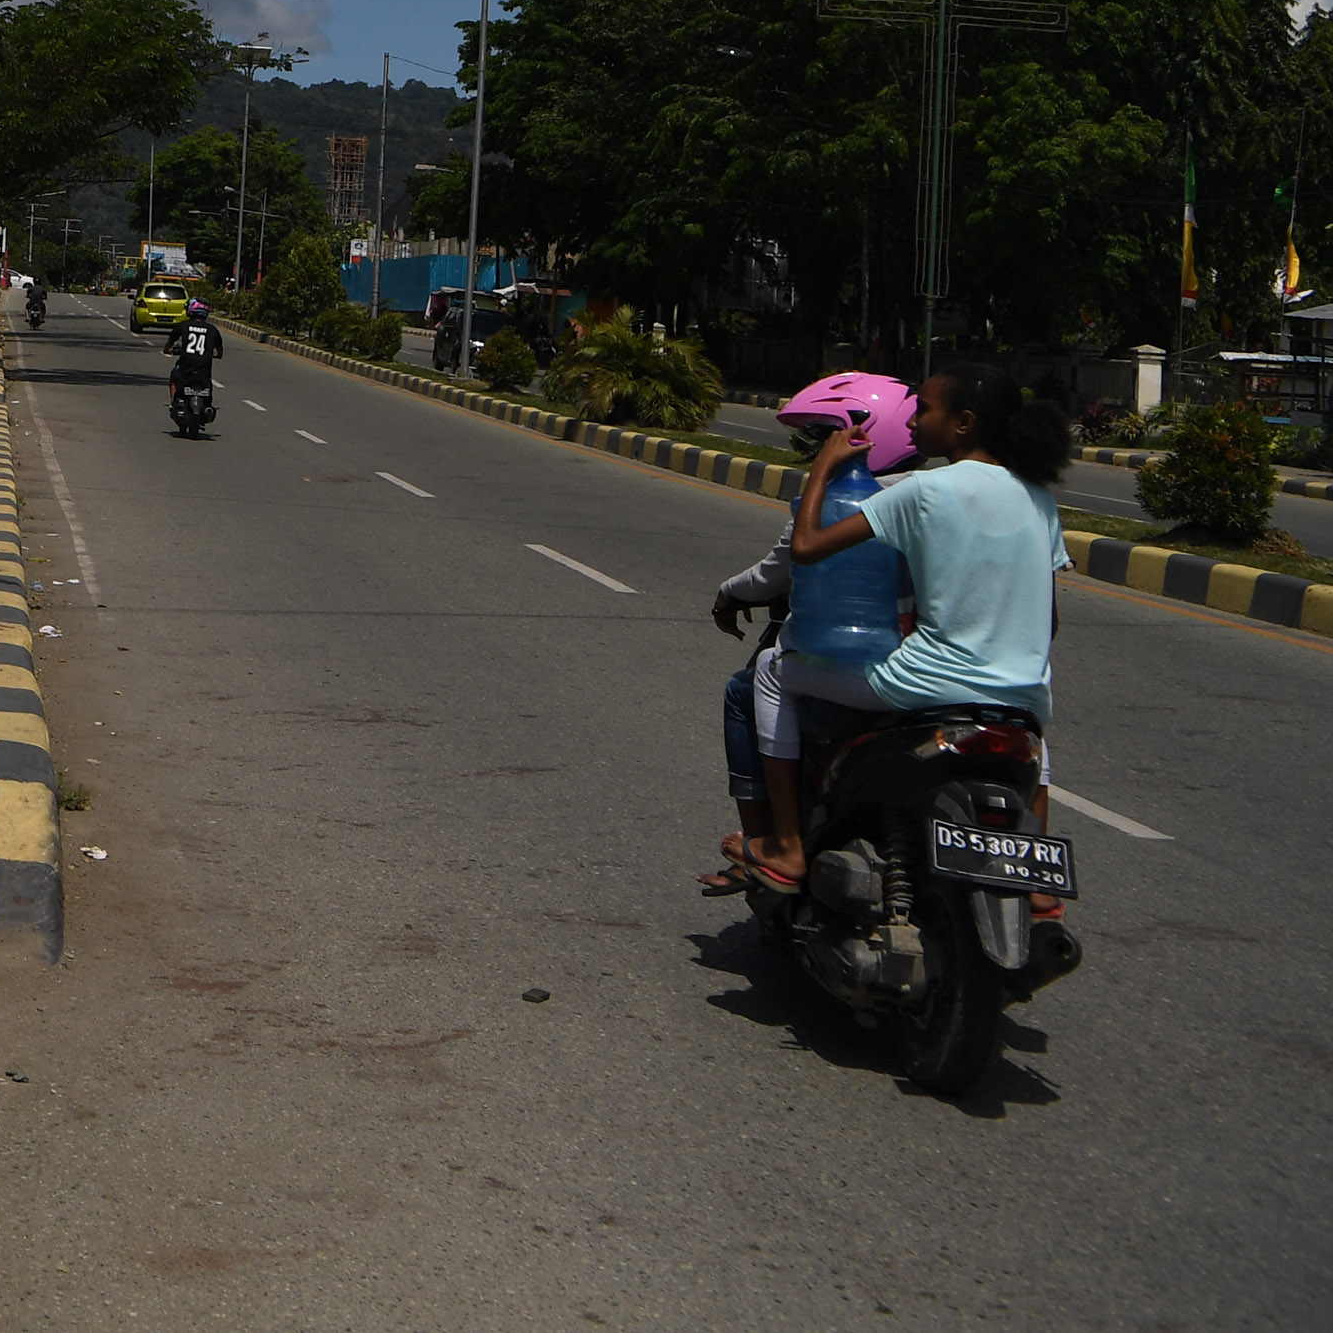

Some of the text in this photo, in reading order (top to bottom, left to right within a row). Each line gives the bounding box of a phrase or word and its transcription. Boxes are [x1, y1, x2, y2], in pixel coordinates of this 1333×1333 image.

[186, 332, 206, 356] 24
[937, 826, 1063, 866] DS 5307 RK
